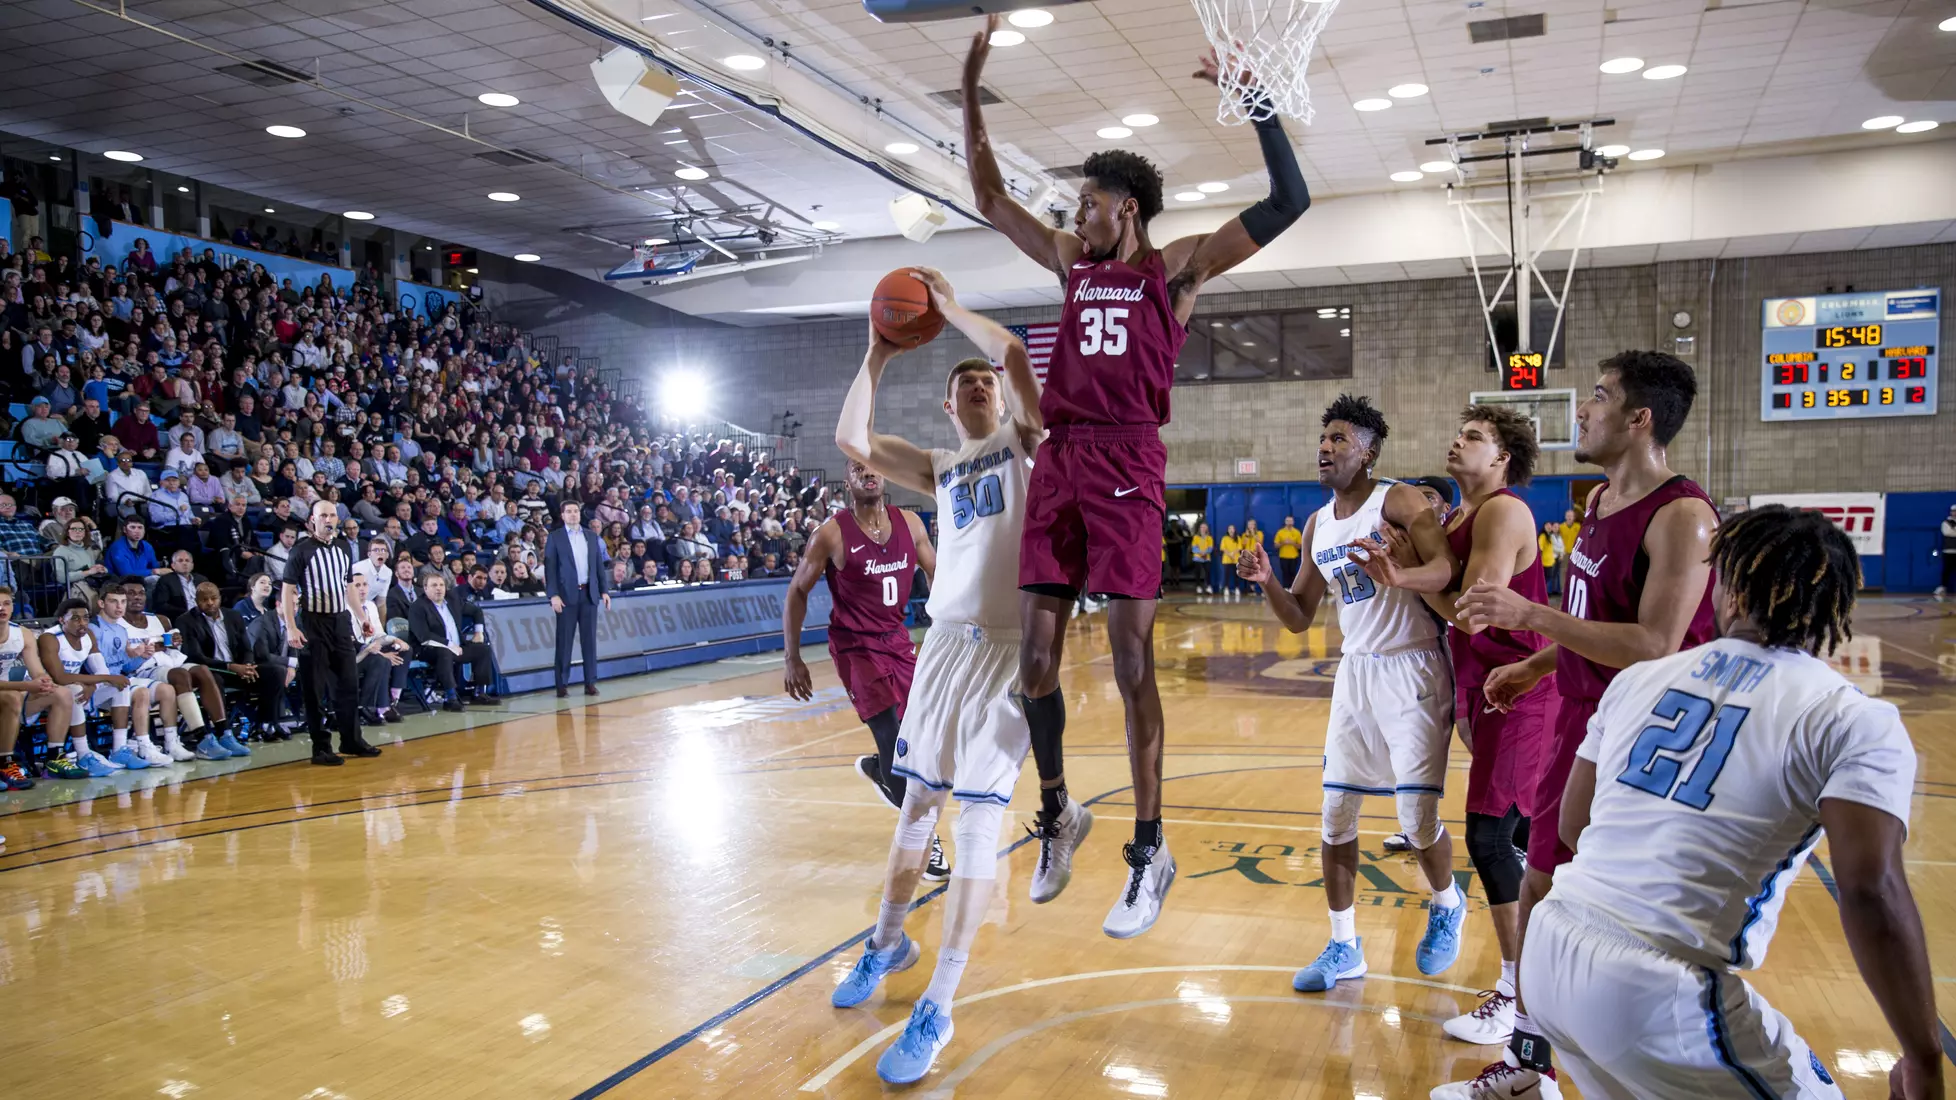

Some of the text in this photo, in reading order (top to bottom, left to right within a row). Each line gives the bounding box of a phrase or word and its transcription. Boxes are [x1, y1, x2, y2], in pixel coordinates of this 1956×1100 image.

[1073, 277, 1146, 303] Harvard
[1080, 307, 1129, 356] 35
[1825, 325, 1881, 348] 15:48
[1509, 353, 1542, 368] 15:48
[1769, 352, 1815, 364] COLUMBIA
[1897, 358, 1925, 379] 37
[1510, 367, 1537, 389] 24
[1781, 364, 1808, 385] 37
[1841, 363, 1854, 380] 2
[1784, 393, 1790, 408] 1
[1803, 391, 1815, 408] 3
[1827, 389, 1851, 407] 35
[1882, 387, 1894, 405] 3
[1912, 386, 1925, 403] 2
[949, 474, 1005, 530] 50
[863, 552, 908, 575] Harvard
[882, 576, 898, 606] 0
[1332, 561, 1376, 605] 13
[1568, 574, 1587, 619] 10
[681, 594, 783, 631] MARKETING
[1691, 650, 1775, 693] SMITH
[1617, 688, 1750, 811] 21
